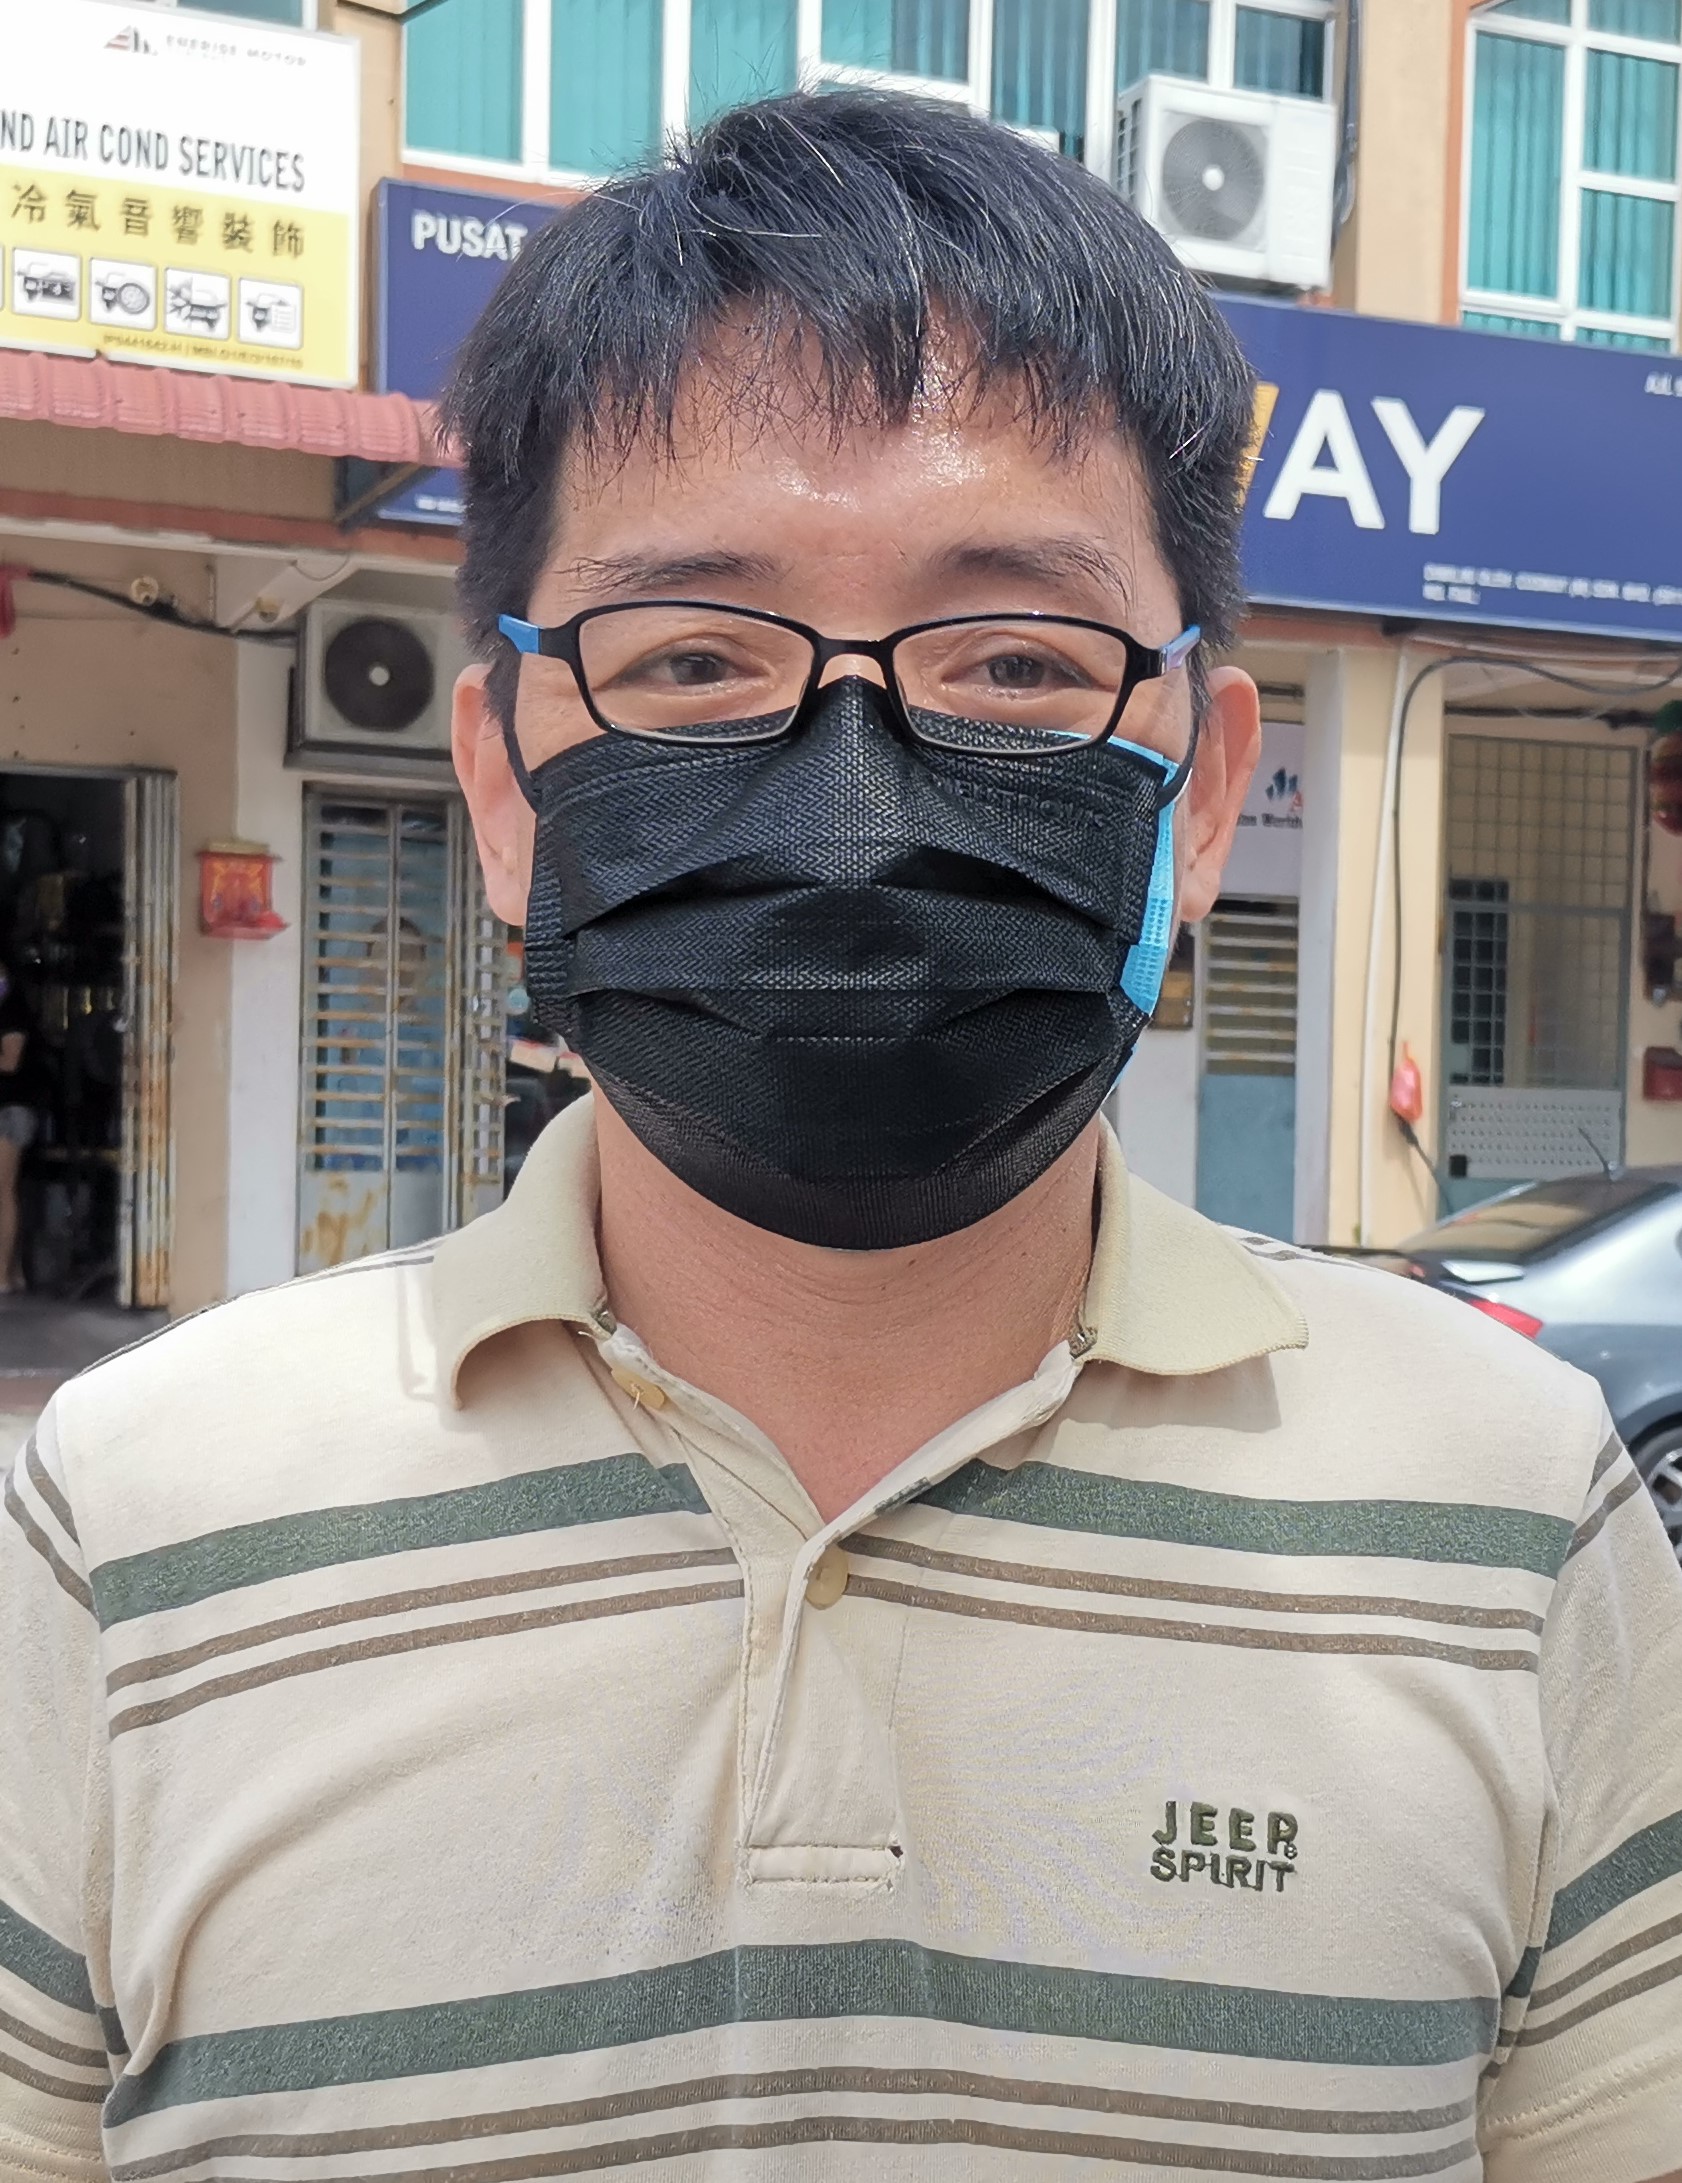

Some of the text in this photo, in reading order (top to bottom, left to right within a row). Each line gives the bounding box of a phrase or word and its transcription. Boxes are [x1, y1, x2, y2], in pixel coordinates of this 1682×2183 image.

[43, 116, 89, 160] AIR
[99, 123, 169, 171] COND
[178, 135, 305, 193] SERVICES
[11, 183, 305, 259] 冷氣音響裝飾
[412, 209, 528, 261] PUSAT
[1239, 381, 1487, 536] AY
[1152, 1800, 1298, 1857] JEEP
[1150, 1847, 1298, 1893] SPIRIT
